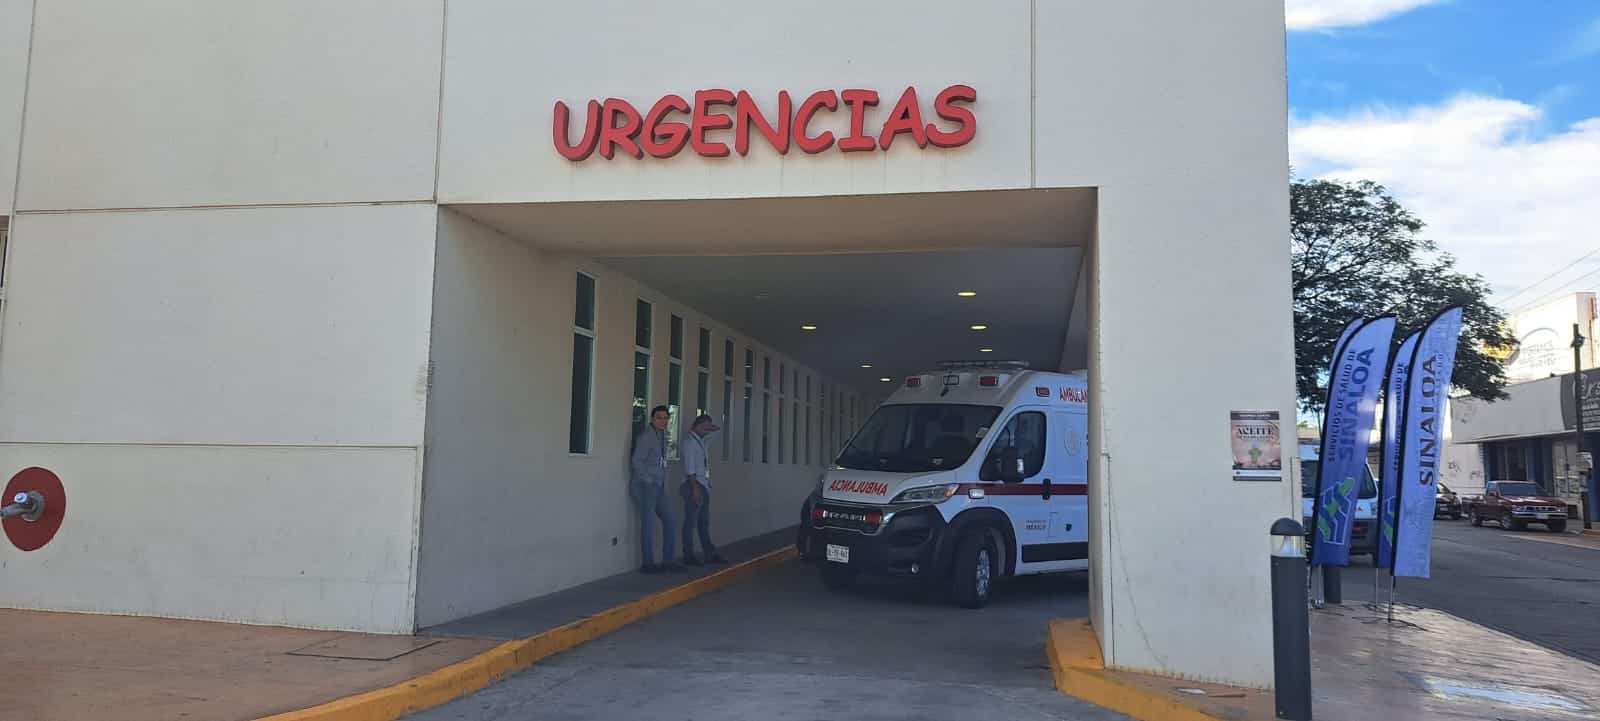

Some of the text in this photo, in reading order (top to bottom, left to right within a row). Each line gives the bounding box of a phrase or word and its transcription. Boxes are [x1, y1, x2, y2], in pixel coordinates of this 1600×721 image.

[552, 84, 977, 161] URGENCIAS
[1336, 398, 1345, 409] DE
[1340, 364, 1352, 393] SALUD
[1340, 347, 1375, 462] SINALOA
[1328, 411, 1342, 463] SERVICIOS
[1420, 355, 1436, 486] SINALOA
